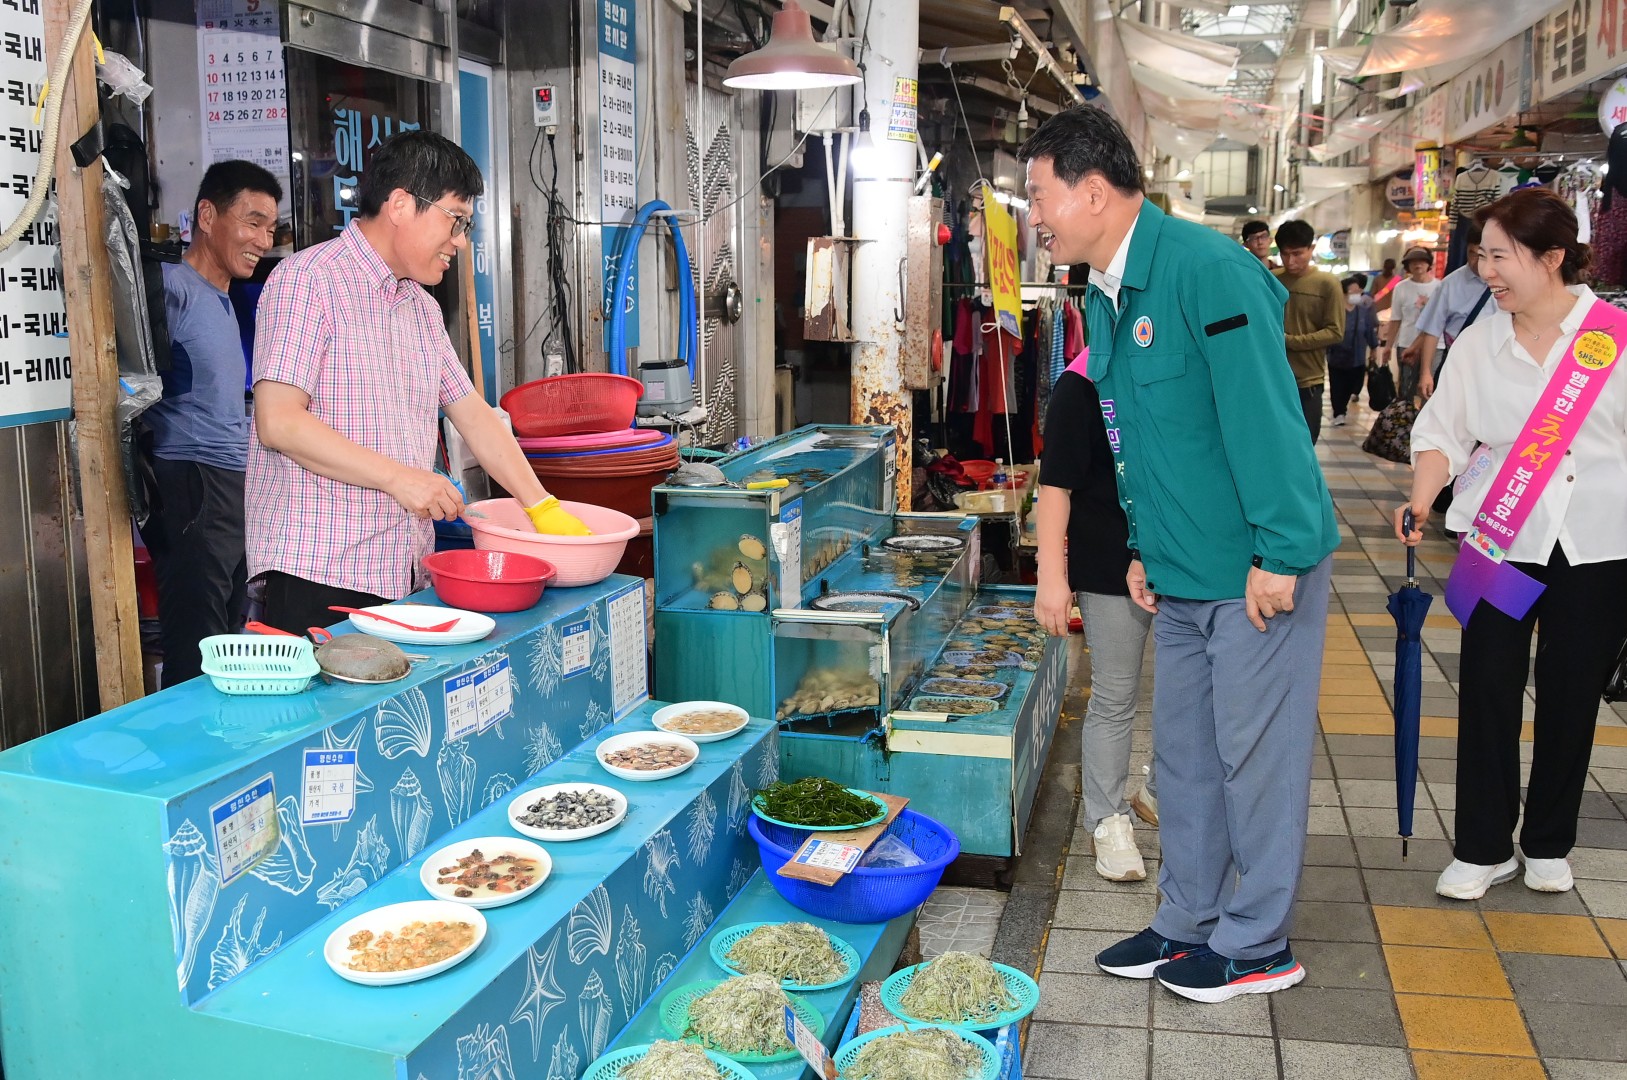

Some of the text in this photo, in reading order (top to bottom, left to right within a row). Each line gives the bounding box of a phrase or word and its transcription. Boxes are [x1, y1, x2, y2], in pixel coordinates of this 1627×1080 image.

[605, 0, 626, 26] 원산지
[220, 20, 227, 28] 月
[234, 19, 243, 27] 火
[605, 24, 627, 49] 표시판
[209, 54, 214, 64] 3
[223, 53, 229, 63] 4
[238, 53, 244, 62] 5
[252, 52, 258, 61] 6
[267, 51, 272, 60] 7
[207, 73, 218, 83] 10
[222, 72, 232, 82] 11
[236, 72, 247, 81] 12
[251, 71, 261, 80] 13
[265, 70, 276, 79] 14
[208, 92, 218, 102] 17
[223, 92, 233, 101] 18
[237, 91, 248, 100] 19
[251, 90, 262, 100] 20
[266, 89, 276, 99] 21
[209, 112, 220, 121] 24
[223, 111, 234, 120] 25
[238, 110, 249, 119] 26
[252, 109, 263, 119] 27
[267, 108, 277, 118] 28
[1492, 466, 1533, 522] 보내세요
[1486, 516, 1515, 538] 해운대구
